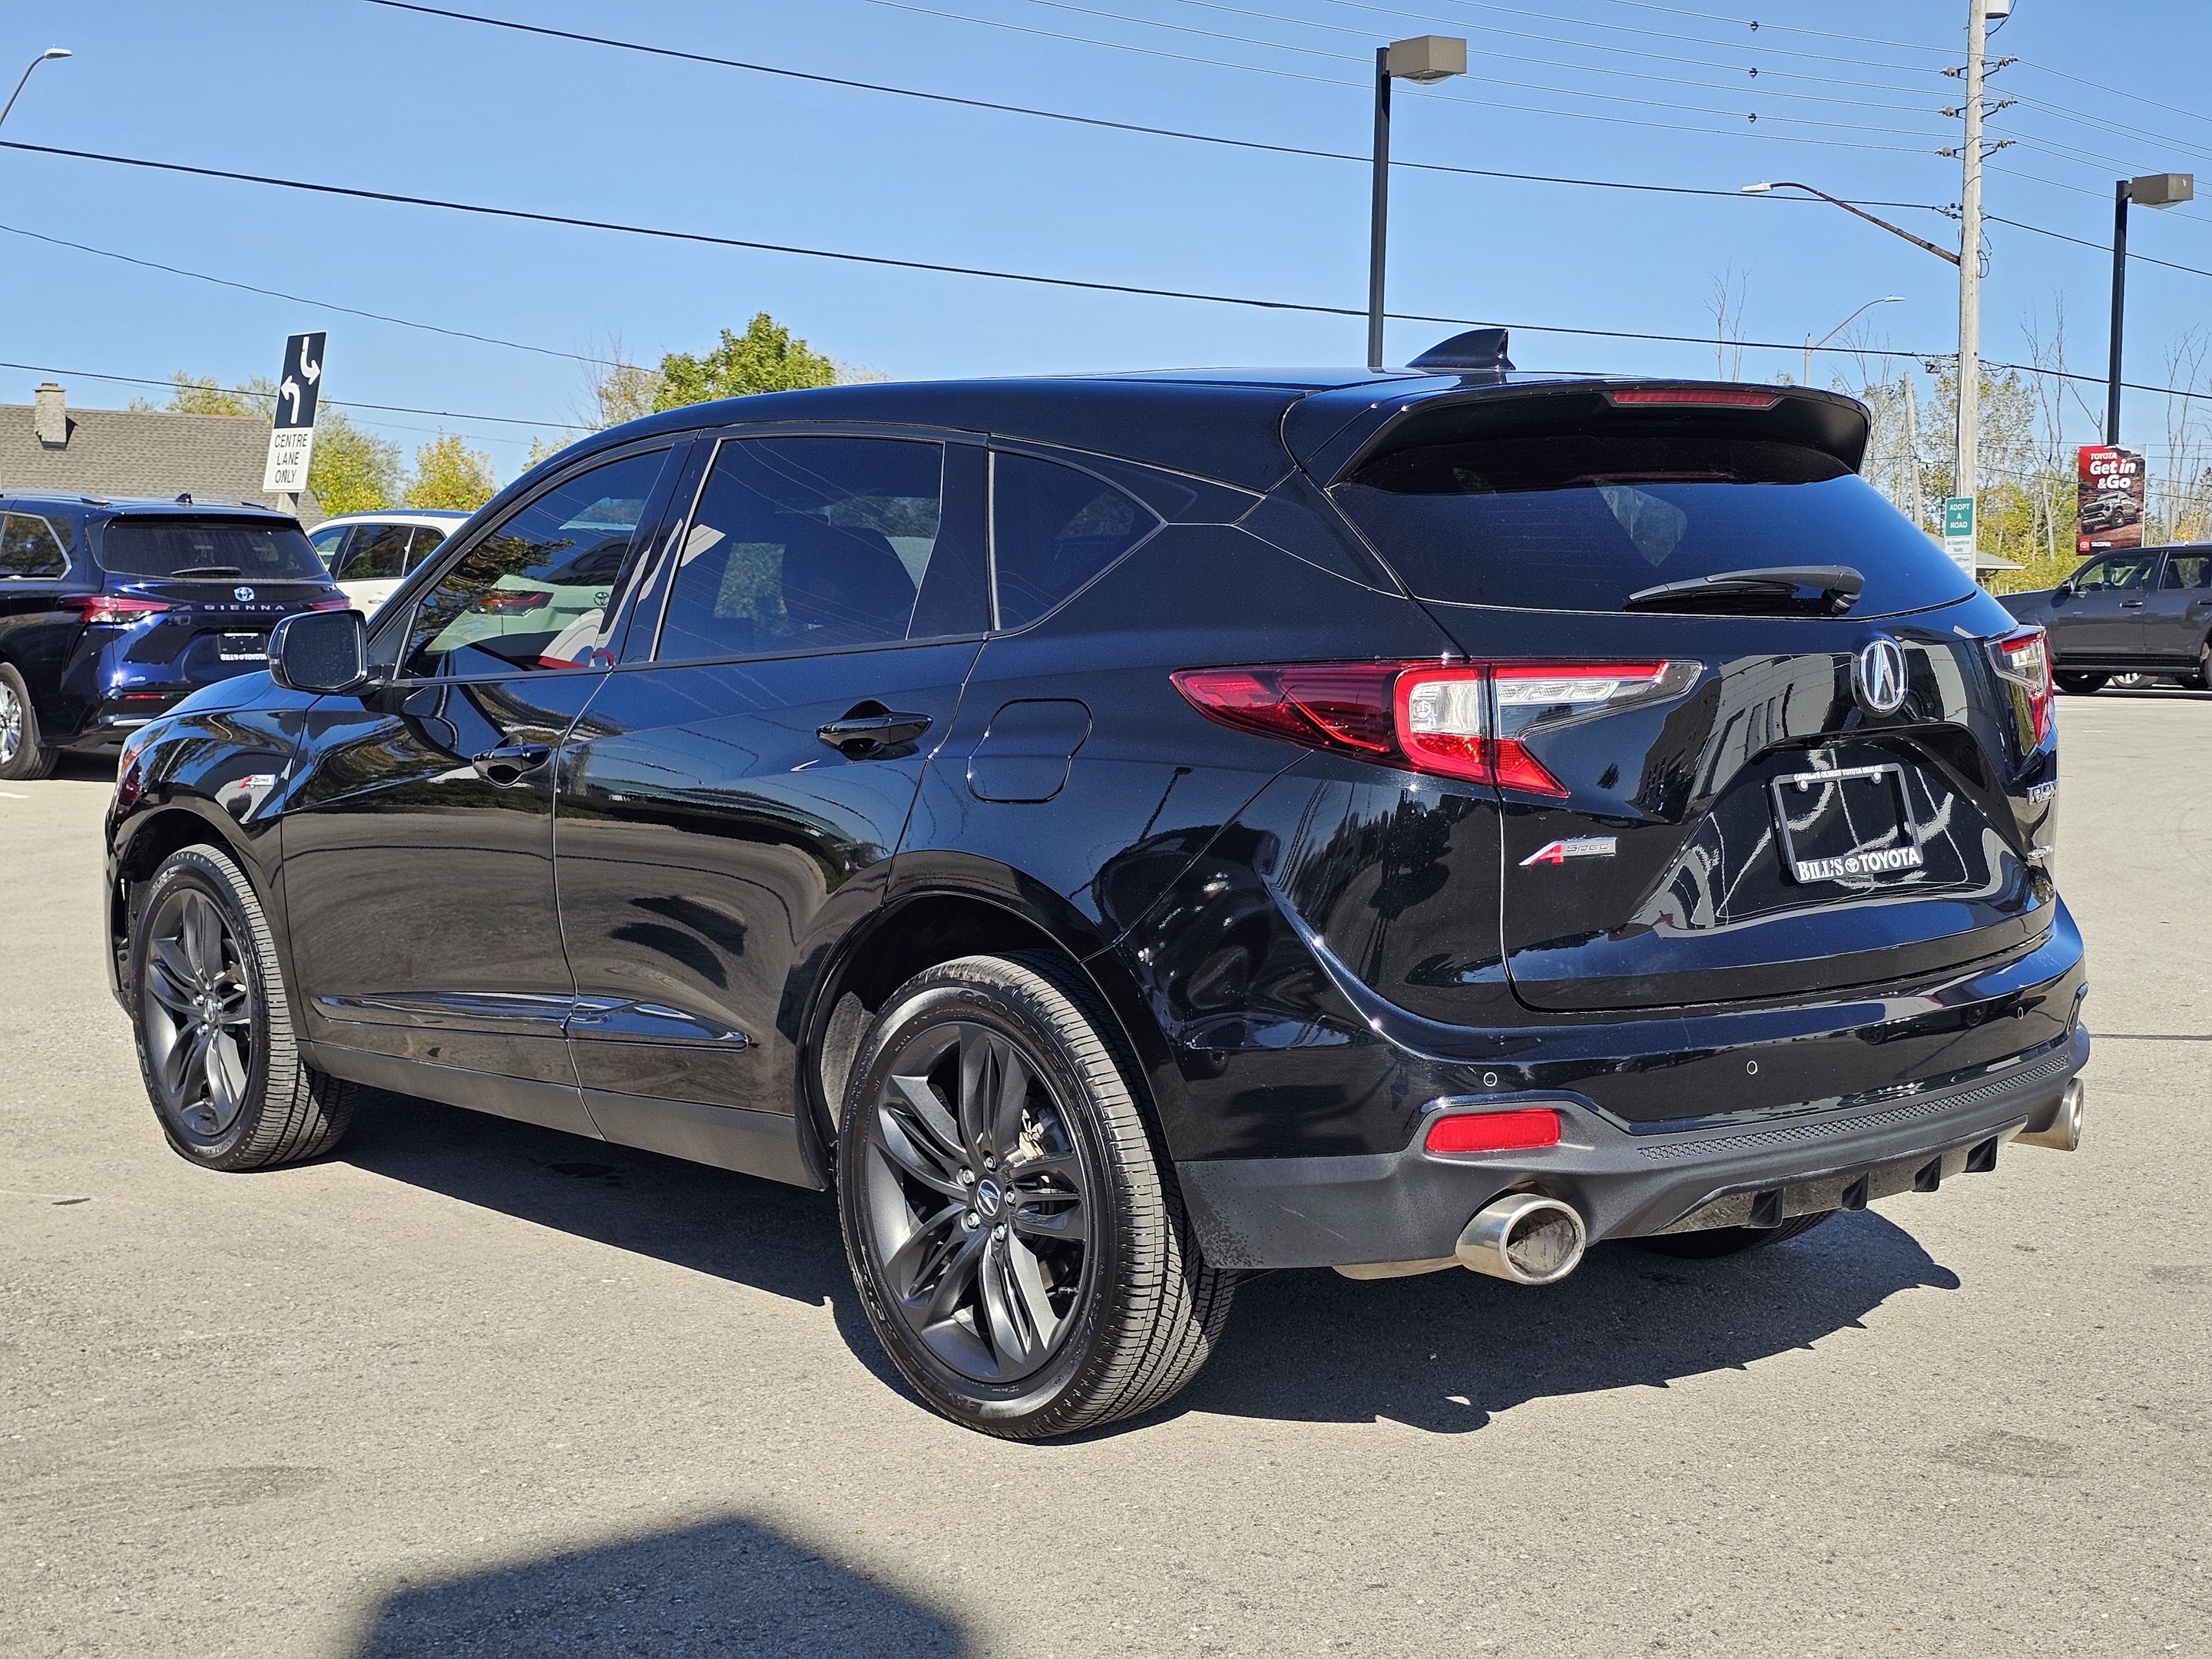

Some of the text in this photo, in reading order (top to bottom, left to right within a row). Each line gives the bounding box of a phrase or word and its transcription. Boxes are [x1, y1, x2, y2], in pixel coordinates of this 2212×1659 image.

[274, 434, 308, 448] CENTRE
[276, 452, 300, 465] LANE
[2090, 459, 2136, 475] Get in
[275, 469, 296, 484] ONLY
[1796, 847, 1920, 881] BILL'S TOYOTA
